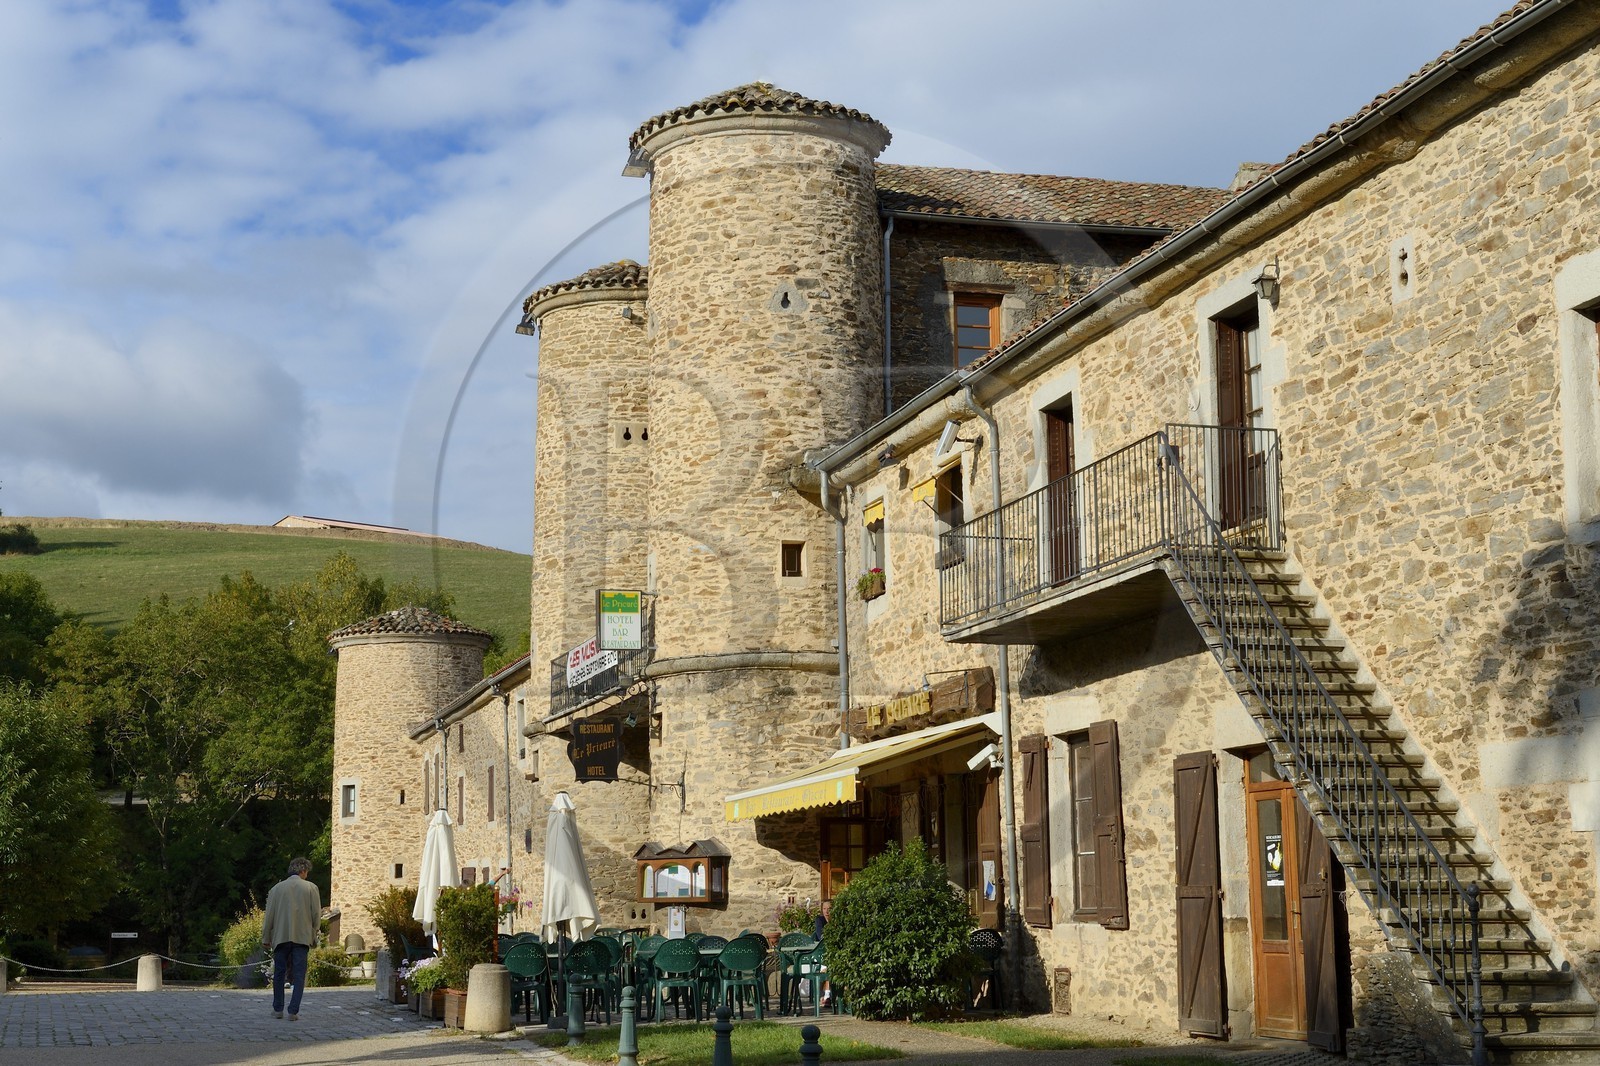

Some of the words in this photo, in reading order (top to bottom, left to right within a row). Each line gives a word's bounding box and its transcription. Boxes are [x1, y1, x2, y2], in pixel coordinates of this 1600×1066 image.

[607, 615, 634, 624] HOTEL
[612, 628, 629, 637] BAR
[601, 640, 640, 649] RESTAURANT
[579, 723, 614, 734] RESTAURANT
[586, 765, 606, 776] HOTEL
